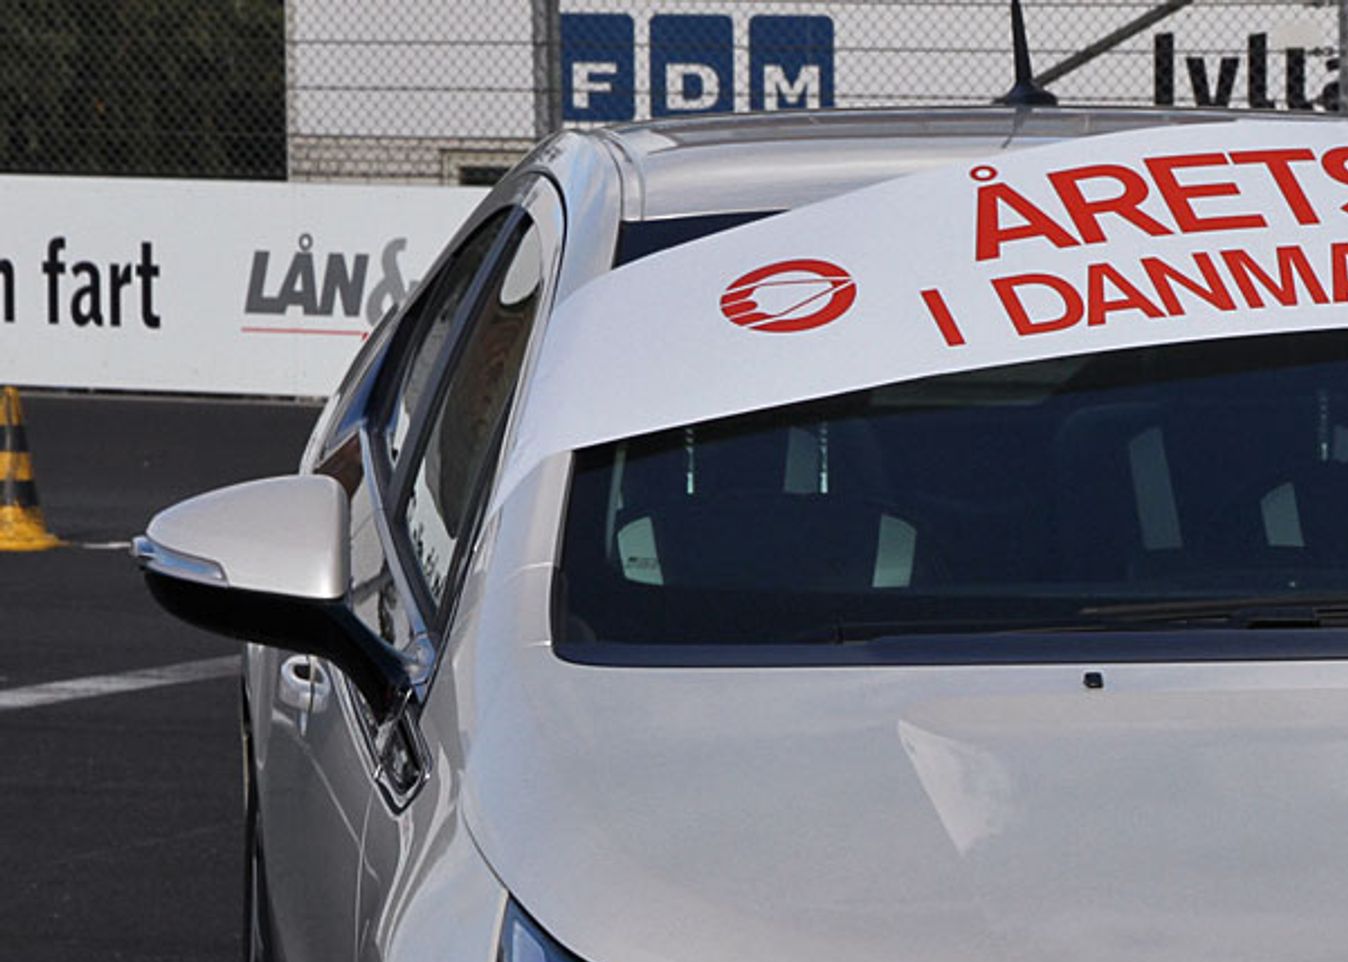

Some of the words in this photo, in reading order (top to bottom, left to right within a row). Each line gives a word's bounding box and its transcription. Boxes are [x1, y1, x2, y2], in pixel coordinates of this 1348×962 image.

[572, 62, 821, 111] FDM
[43, 237, 160, 328] fart
[921, 288, 966, 346] I
